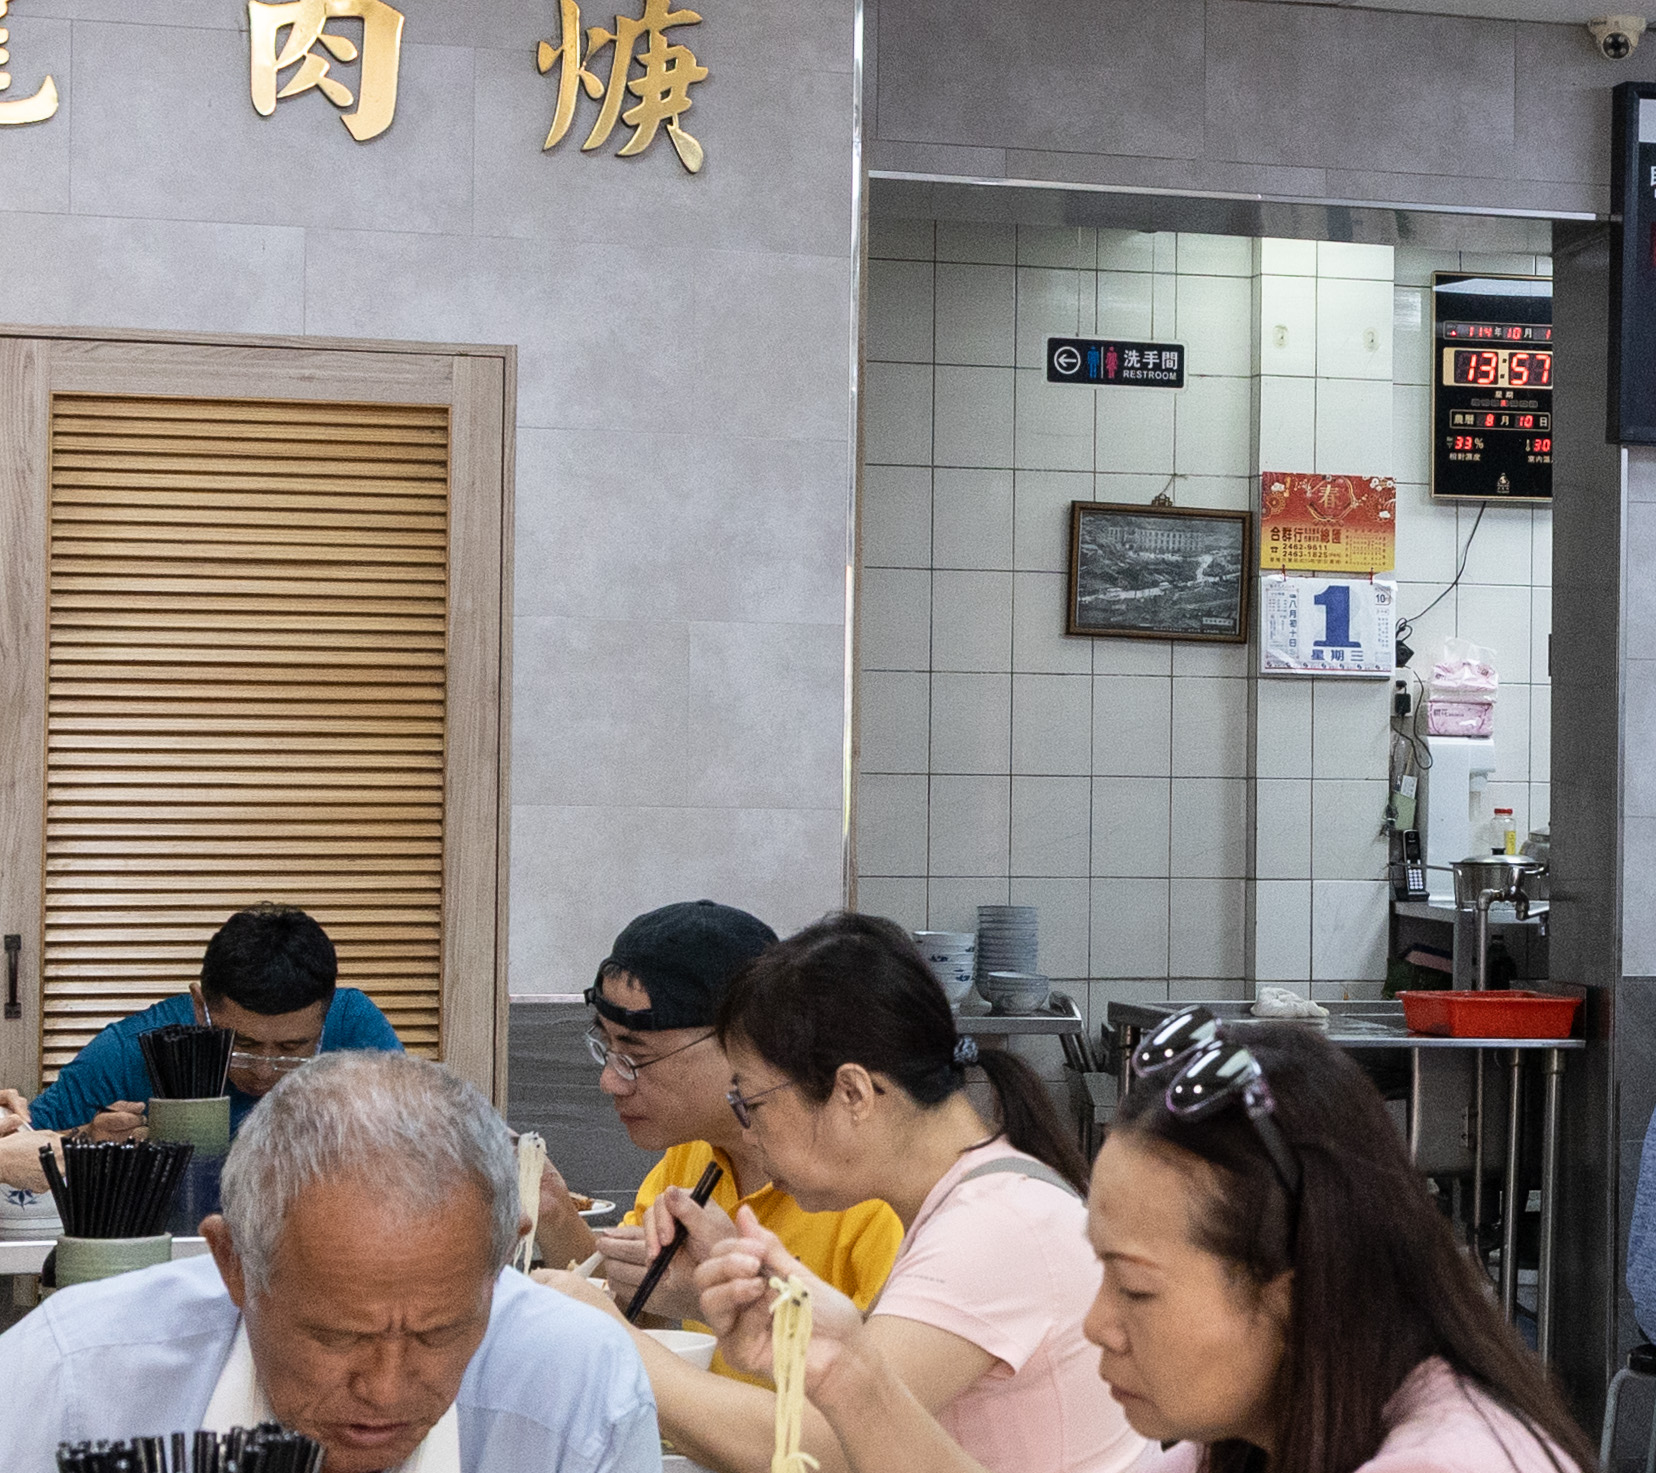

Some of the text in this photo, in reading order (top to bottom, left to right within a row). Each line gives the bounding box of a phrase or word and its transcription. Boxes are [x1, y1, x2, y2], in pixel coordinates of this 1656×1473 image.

[1523, 327, 1533, 339] 月
[1123, 349, 1178, 370] 洗手間
[1122, 369, 1177, 380] RESTROOM
[1467, 352, 1552, 385] 13:57
[1500, 415, 1510, 426] 月
[1539, 416, 1548, 427] 日
[1454, 436, 1473, 450] 33
[1313, 585, 1362, 648] 1
[1311, 649, 1365, 662] 星期三
